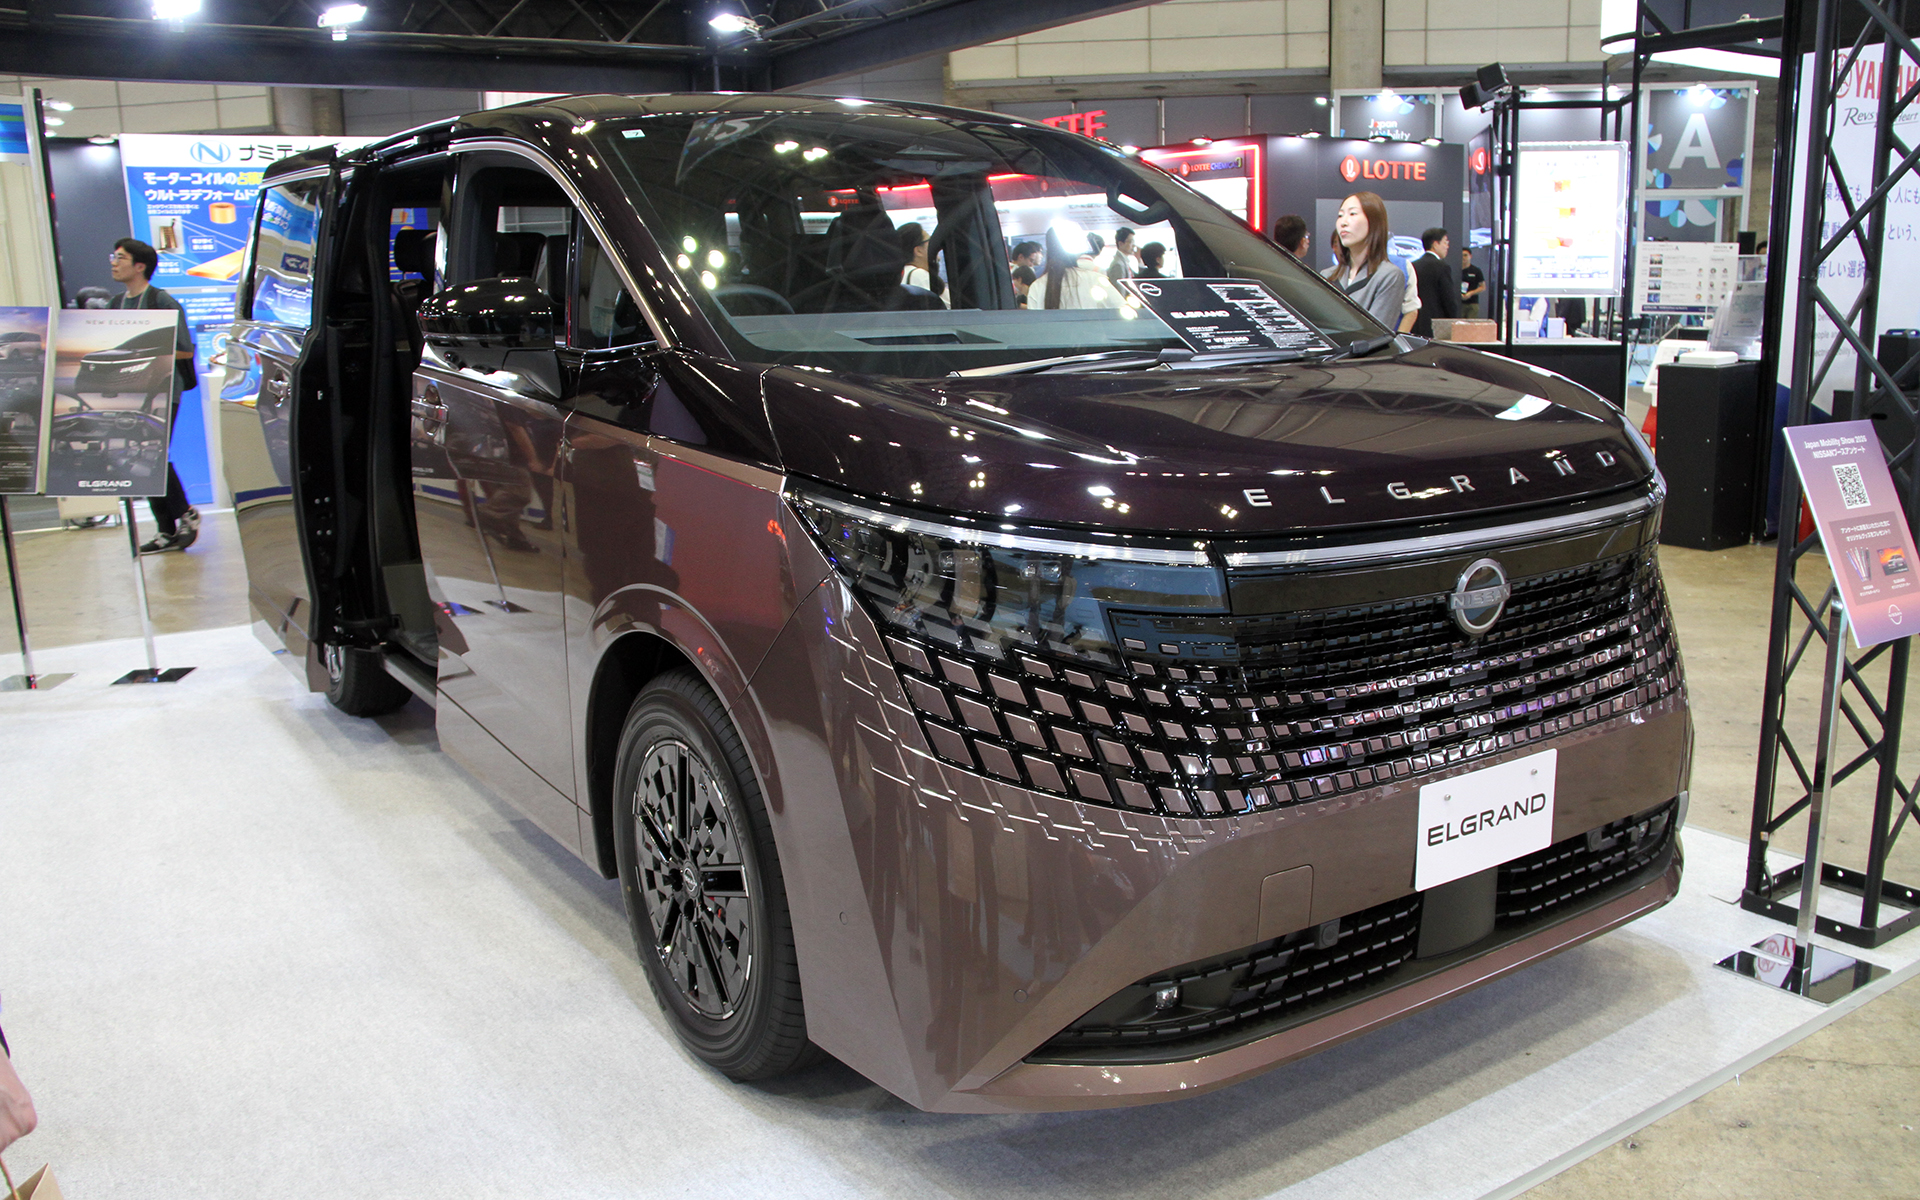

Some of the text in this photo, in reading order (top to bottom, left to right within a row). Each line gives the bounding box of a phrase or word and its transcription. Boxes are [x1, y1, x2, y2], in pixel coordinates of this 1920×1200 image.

[1042, 110, 1107, 142] TTE
[1368, 118, 1398, 131] Japan
[1843, 107, 1918, 126] Revs eart
[1668, 113, 1721, 170] A
[1362, 159, 1427, 181] LOTTE
[1170, 310, 1231, 319] ELGRAND
[1243, 450, 1617, 507] ELGRAND
[1454, 588, 1509, 608] NISSAN
[1427, 793, 1546, 847] ELGRAND
